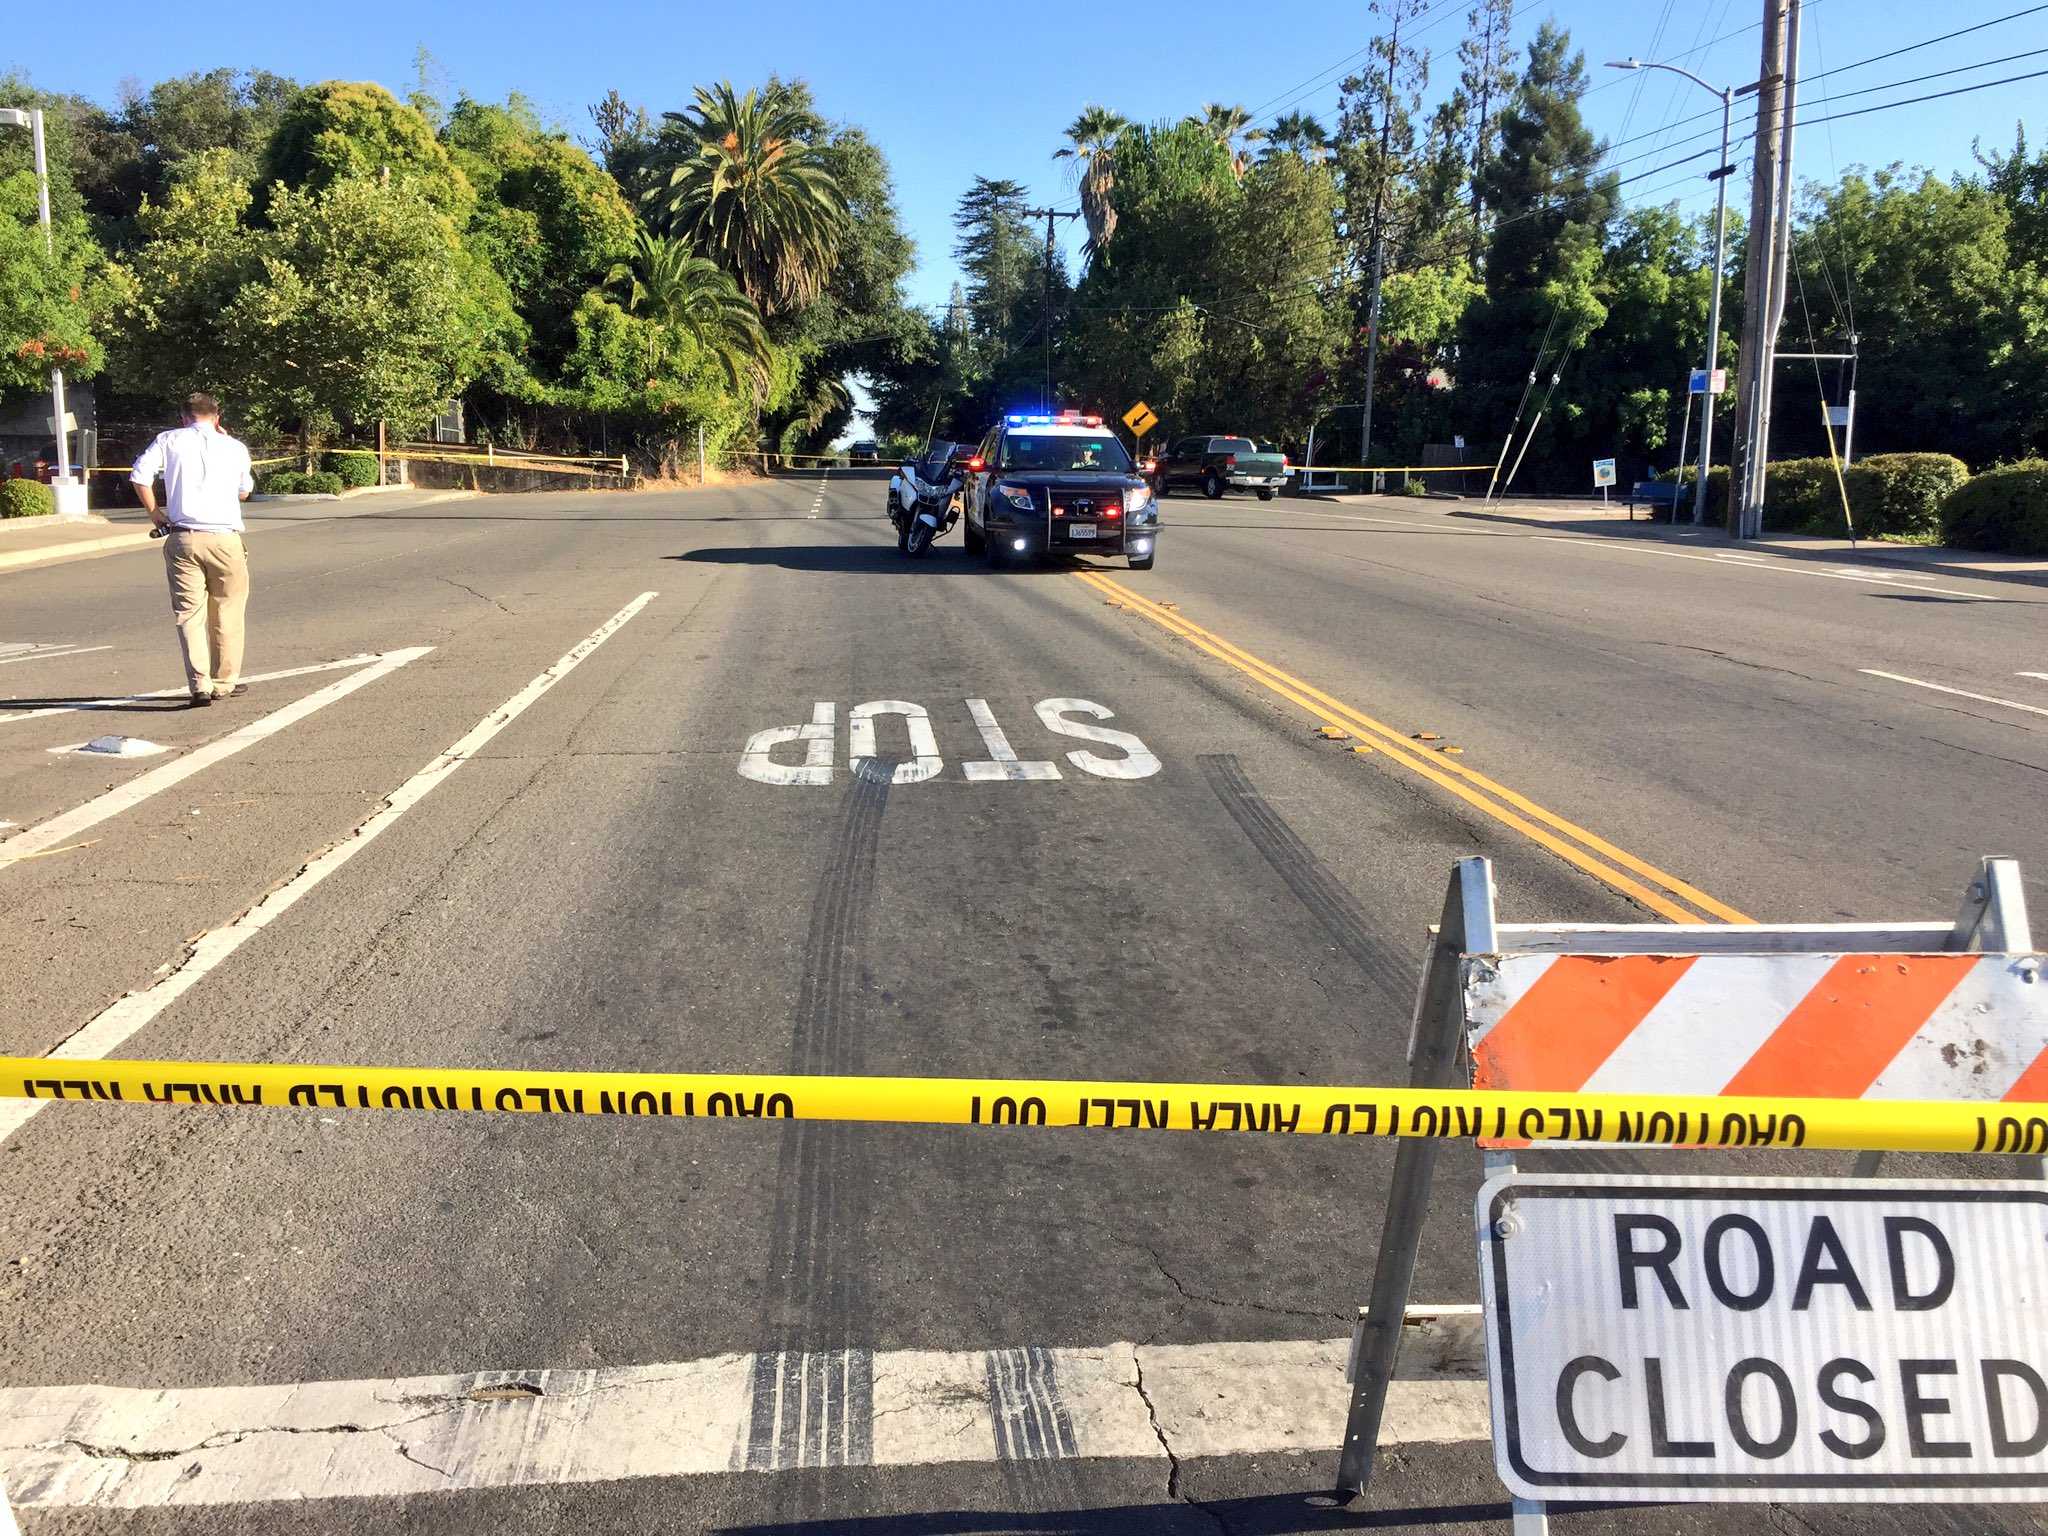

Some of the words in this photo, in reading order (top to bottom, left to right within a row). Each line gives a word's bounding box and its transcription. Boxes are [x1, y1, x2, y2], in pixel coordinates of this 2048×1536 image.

[738, 698, 1162, 785] STOP
[1613, 1213, 1956, 1312] ROAD
[1555, 1355, 2048, 1460] CLOSED
